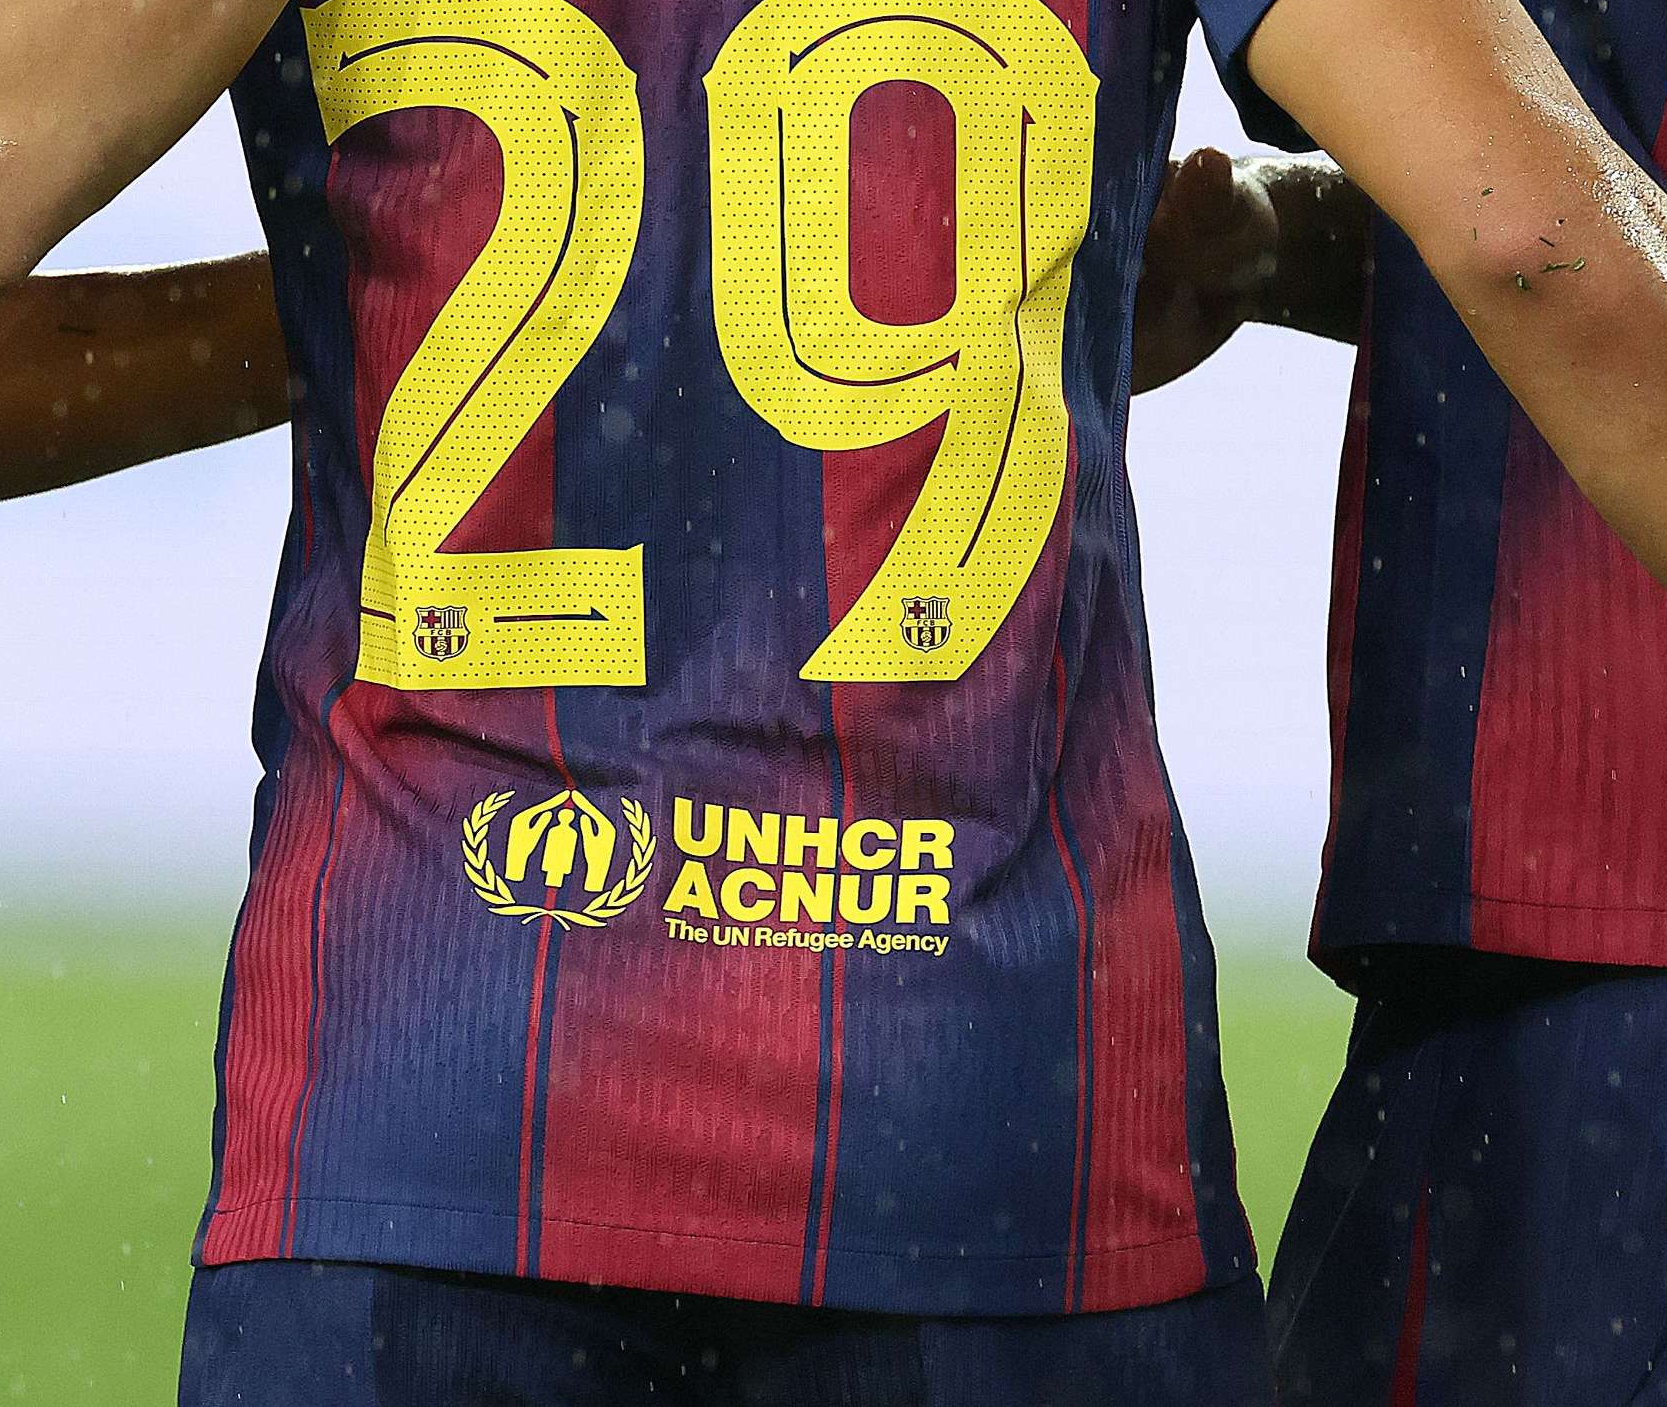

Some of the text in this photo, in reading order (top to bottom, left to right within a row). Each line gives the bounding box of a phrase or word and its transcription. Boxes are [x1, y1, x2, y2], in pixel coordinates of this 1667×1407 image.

[673, 796, 955, 869] UNHCR
[663, 860, 950, 925] ACNUR
[663, 917, 950, 956] The UN Refugee Agency
